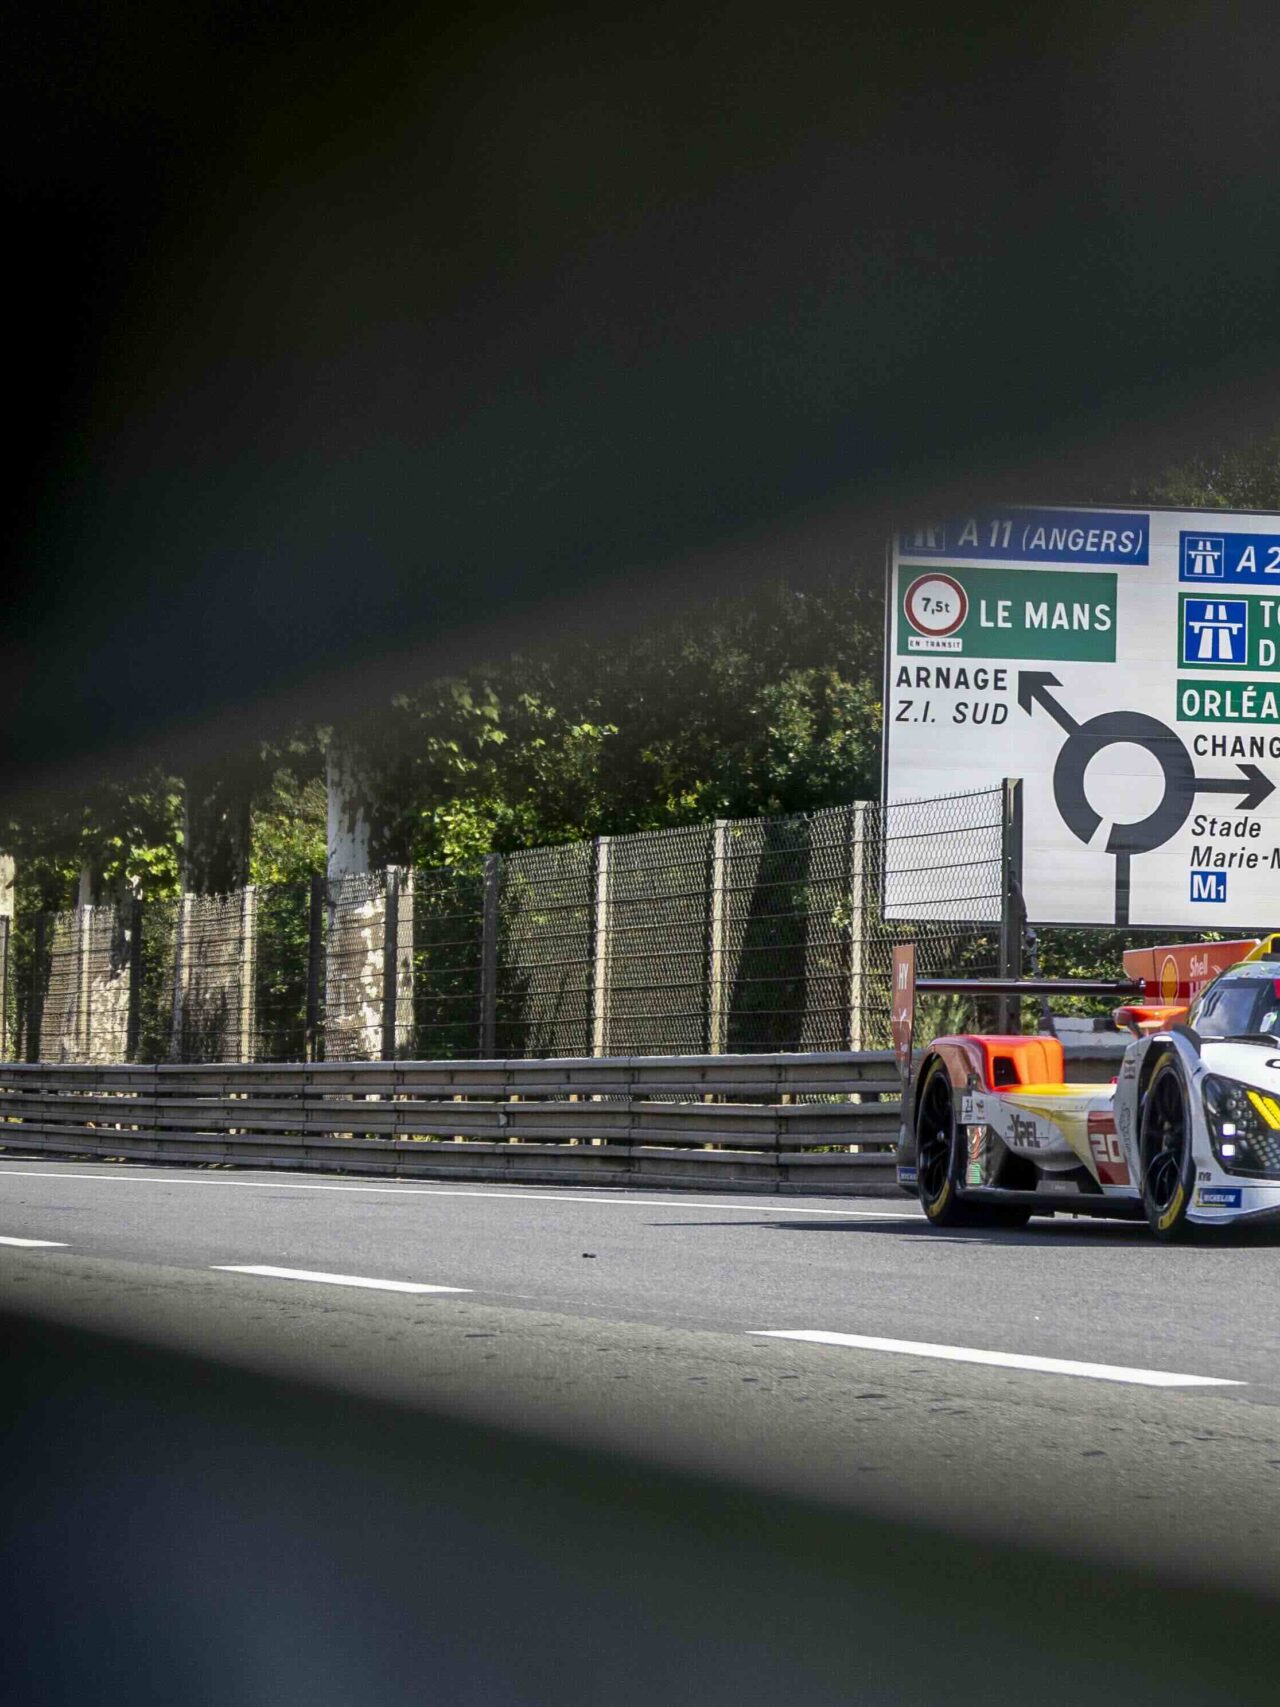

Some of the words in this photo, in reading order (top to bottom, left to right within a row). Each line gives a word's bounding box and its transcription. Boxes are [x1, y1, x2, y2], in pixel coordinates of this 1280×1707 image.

[957, 519, 979, 547] A
[989, 520, 1013, 548] 11
[1022, 525, 1143, 555] (ANGERS)
[1235, 545, 1257, 573] A
[921, 597, 951, 615] 7,5t
[980, 600, 1013, 628] LE
[1025, 601, 1112, 631] MANS
[925, 640, 961, 649] TRANSIT
[896, 666, 1009, 691] ARNAGE
[895, 700, 937, 723] Z.I.
[952, 702, 1009, 725] SUD
[1191, 814, 1262, 838] Stade
[1010, 1114, 1041, 1149] XPEL
[1090, 1133, 1127, 1164] 20
